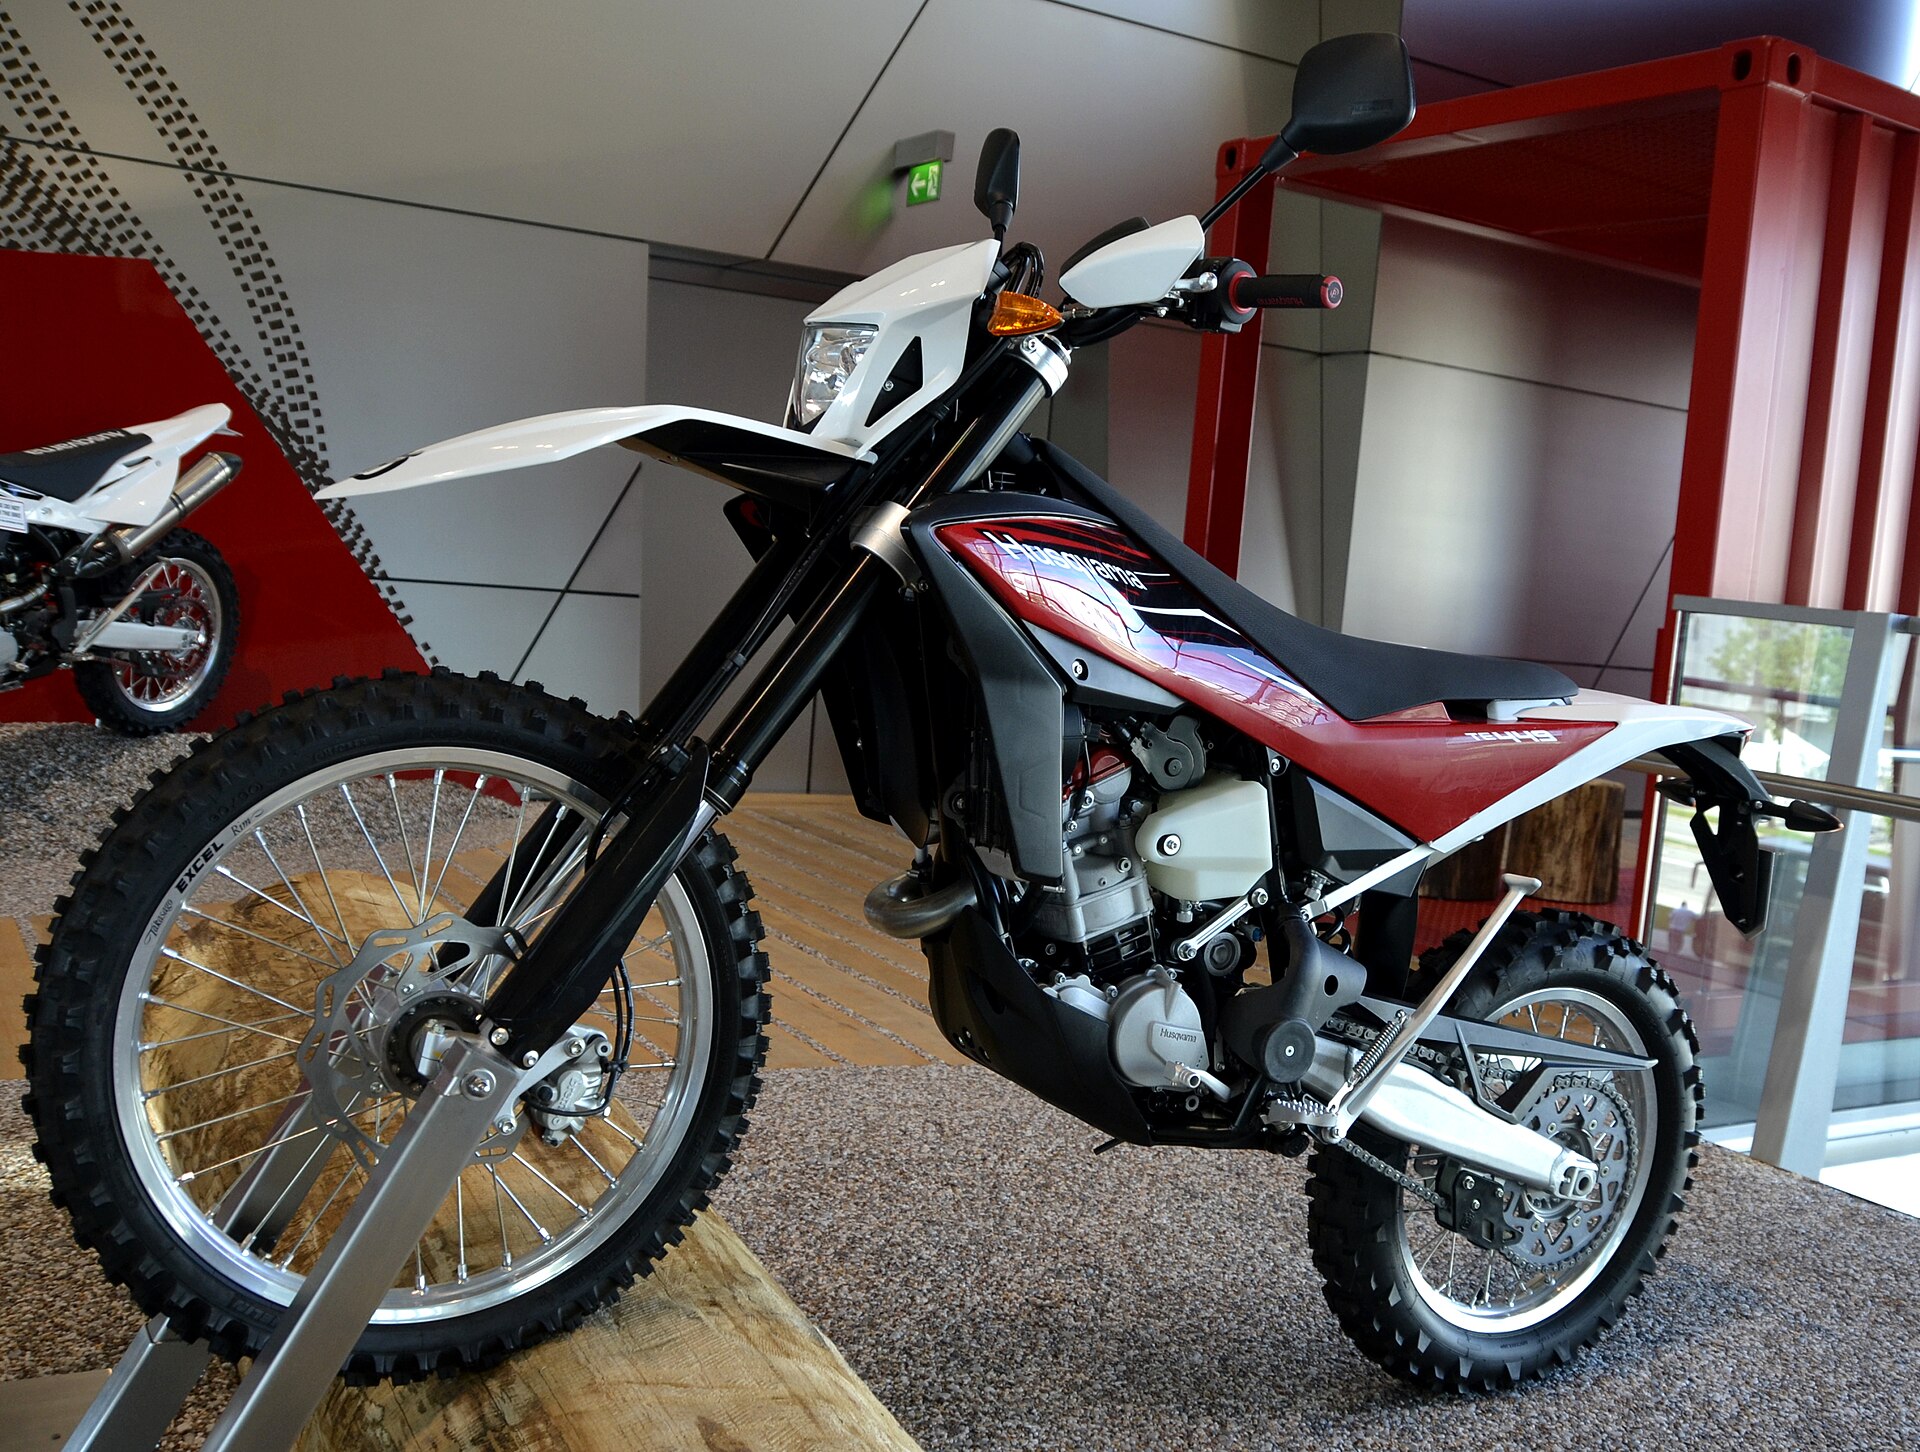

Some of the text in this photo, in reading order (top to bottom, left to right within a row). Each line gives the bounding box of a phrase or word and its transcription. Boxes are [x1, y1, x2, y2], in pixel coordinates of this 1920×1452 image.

[983, 531, 1148, 590] Husqvarna
[175, 841, 224, 894] EXCEL
[230, 817, 252, 837] Rim
[1160, 1028, 1197, 1043] Husqvarna
